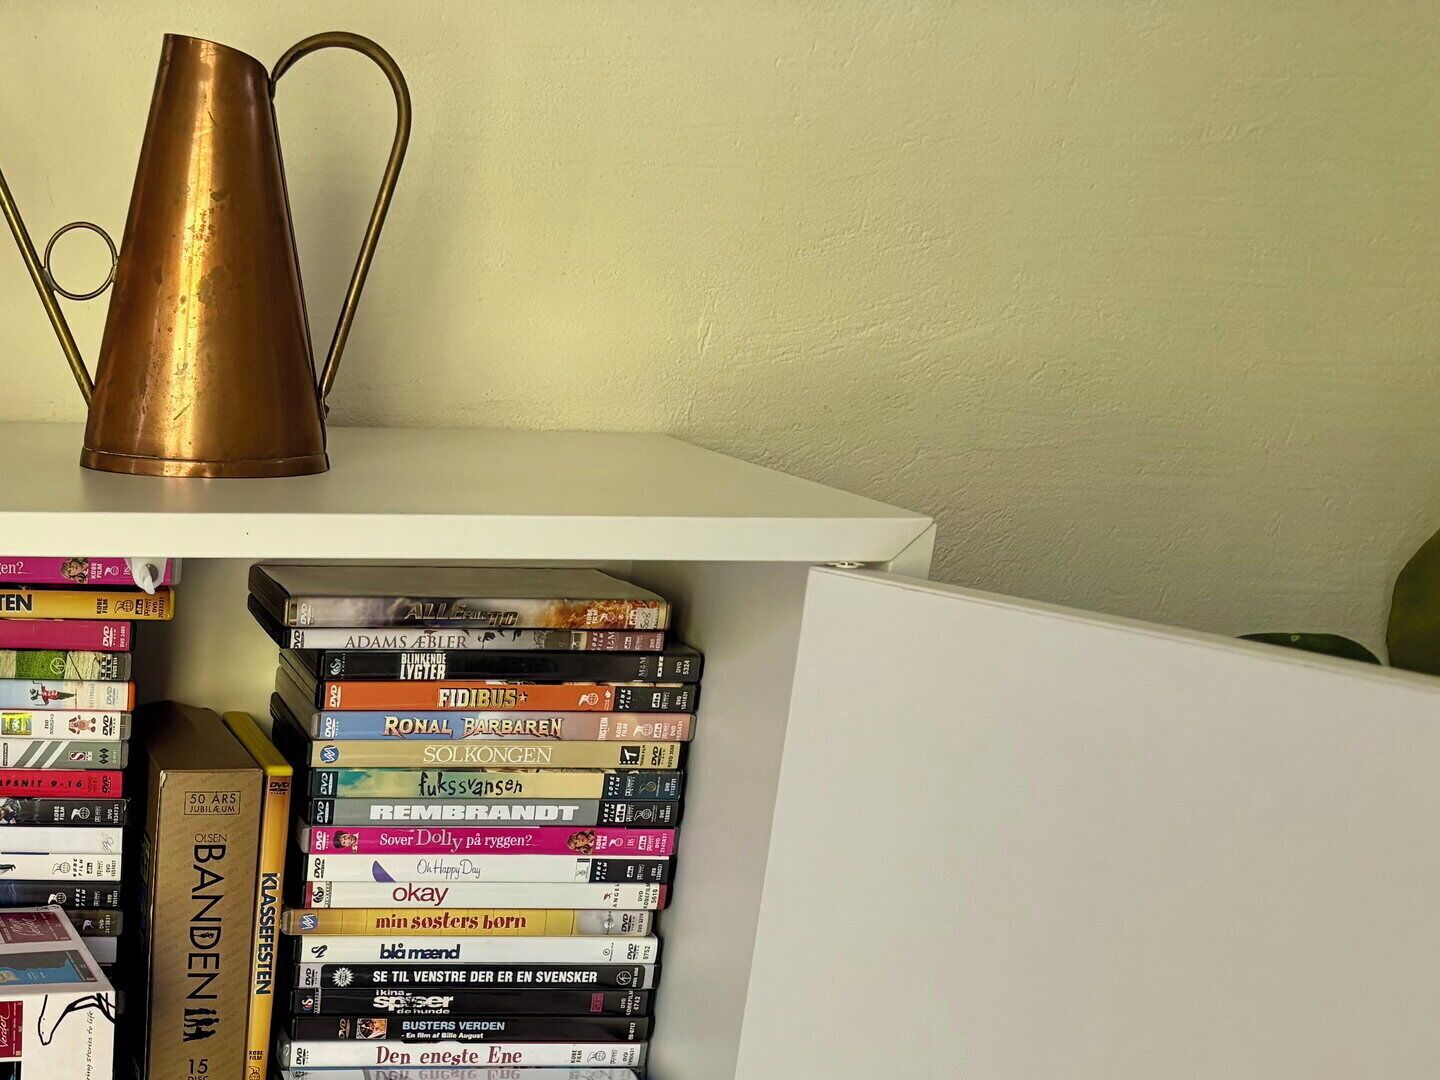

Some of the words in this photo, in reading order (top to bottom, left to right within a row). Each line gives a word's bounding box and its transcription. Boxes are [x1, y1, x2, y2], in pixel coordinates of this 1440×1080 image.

[345, 635, 407, 649] ADAMS
[412, 635, 468, 649] ÆBLER
[401, 653, 447, 664] BLINKENDE
[400, 663, 446, 680] LYGTER
[437, 687, 519, 709] FIDIBUS
[382, 715, 454, 738] RONAL
[461, 716, 564, 738] BARBAREN
[423, 746, 553, 764] SOLKONGEN
[189, 792, 208, 804] 50
[210, 789, 237, 804] ÅRS
[190, 804, 236, 814] JUBILÆUM
[369, 804, 580, 821] REMBRANDT
[194, 832, 227, 844] OLSEN
[379, 833, 414, 846] Sover
[415, 828, 463, 853] Dolly
[466, 833, 482, 850] på
[484, 834, 533, 850] ryggen?
[392, 883, 449, 906] okay
[186, 844, 227, 1000] BANDEN
[376, 913, 408, 930] min
[411, 912, 478, 930] søsters
[482, 914, 527, 930] børn
[256, 872, 280, 995] KLASSEFESTEN
[380, 943, 405, 960] blå
[408, 943, 461, 960] mænd
[373, 970, 389, 983] SE
[392, 970, 410, 983] TIL
[414, 970, 466, 983] VENSTRE
[470, 971, 494, 983] DER
[497, 971, 514, 983] ER
[516, 971, 533, 983] EN
[536, 971, 598, 983] SVENSKER
[402, 1021, 455, 1031] BUSTERS
[459, 1021, 505, 1032] VERDEN
[375, 1045, 412, 1064] Den
[419, 1047, 479, 1067] eneste
[486, 1045, 522, 1064] Ene
[188, 1057, 209, 1075] 15
